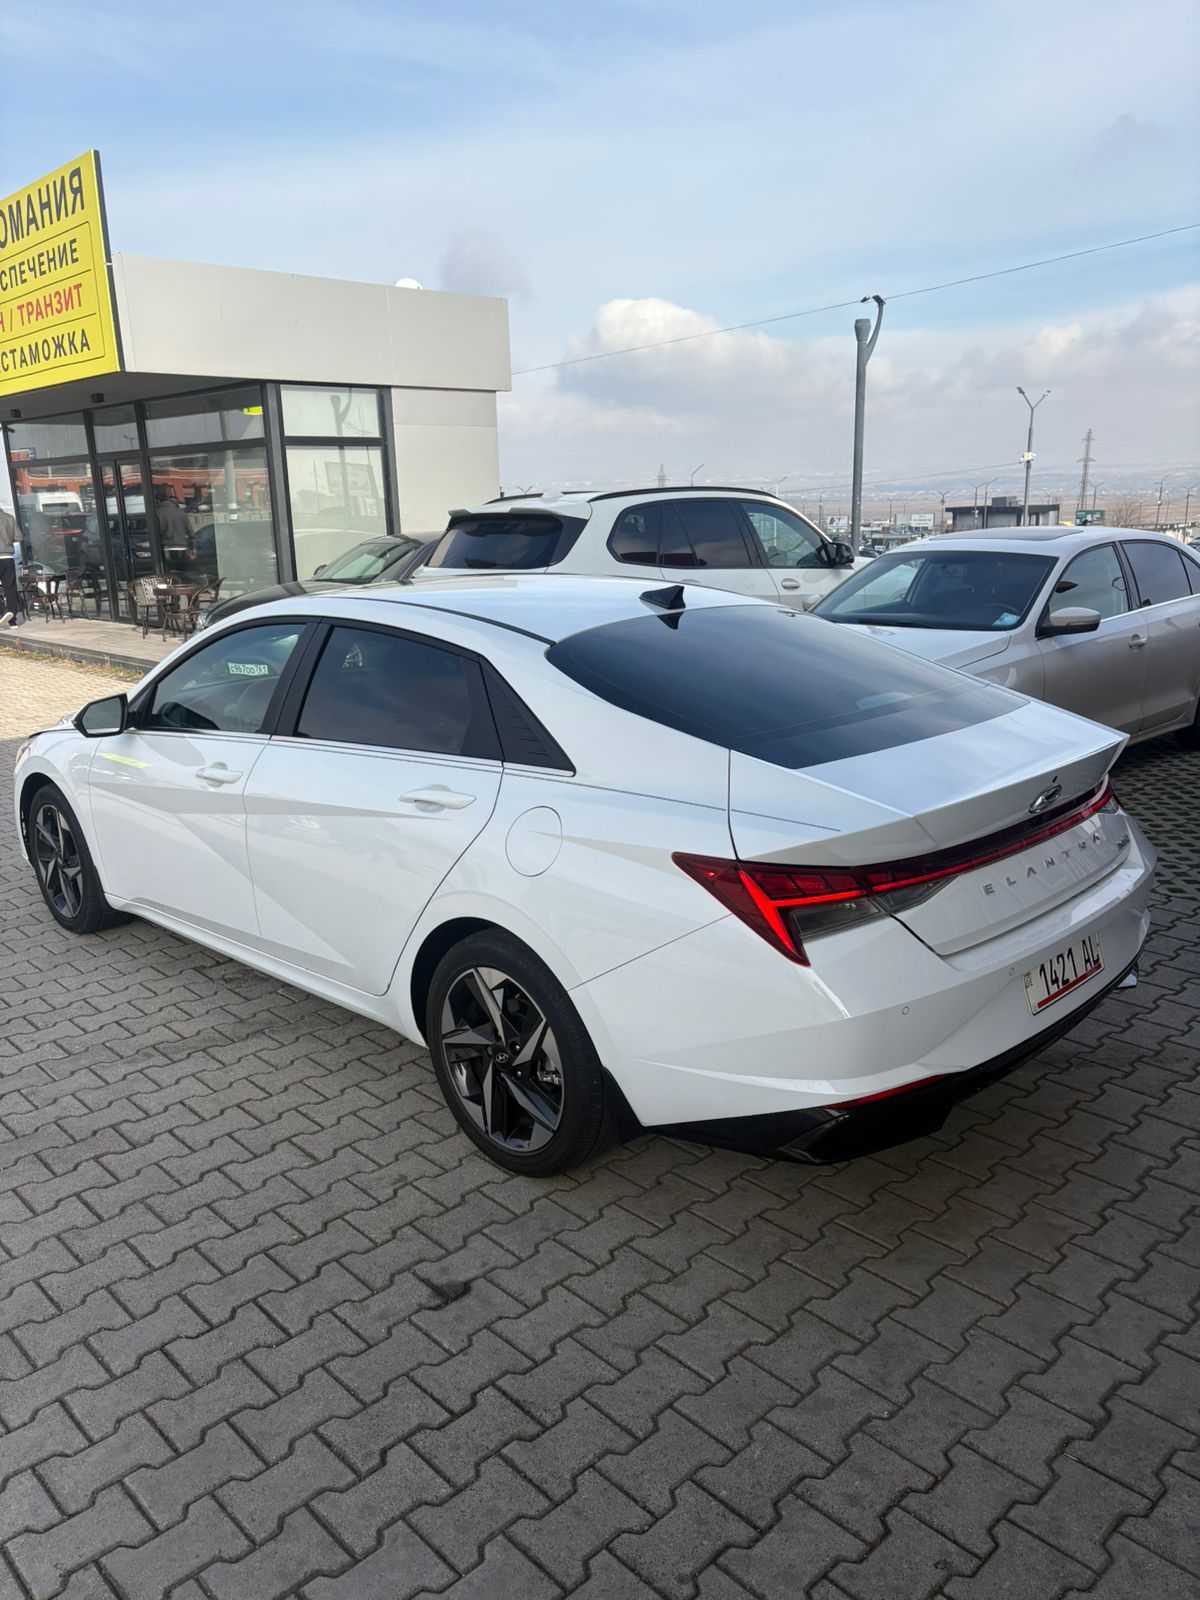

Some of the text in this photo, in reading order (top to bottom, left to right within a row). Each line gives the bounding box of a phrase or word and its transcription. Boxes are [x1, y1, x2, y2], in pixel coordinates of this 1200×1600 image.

[0, 238, 79, 291] СПЕЧЕНИЕ
[17, 283, 83, 327] ТРАНЗИТ
[1, 328, 91, 372] СТАМОЖКА
[982, 832, 1100, 895] ELANTRA
[1039, 935, 1099, 996] 1421 AL
